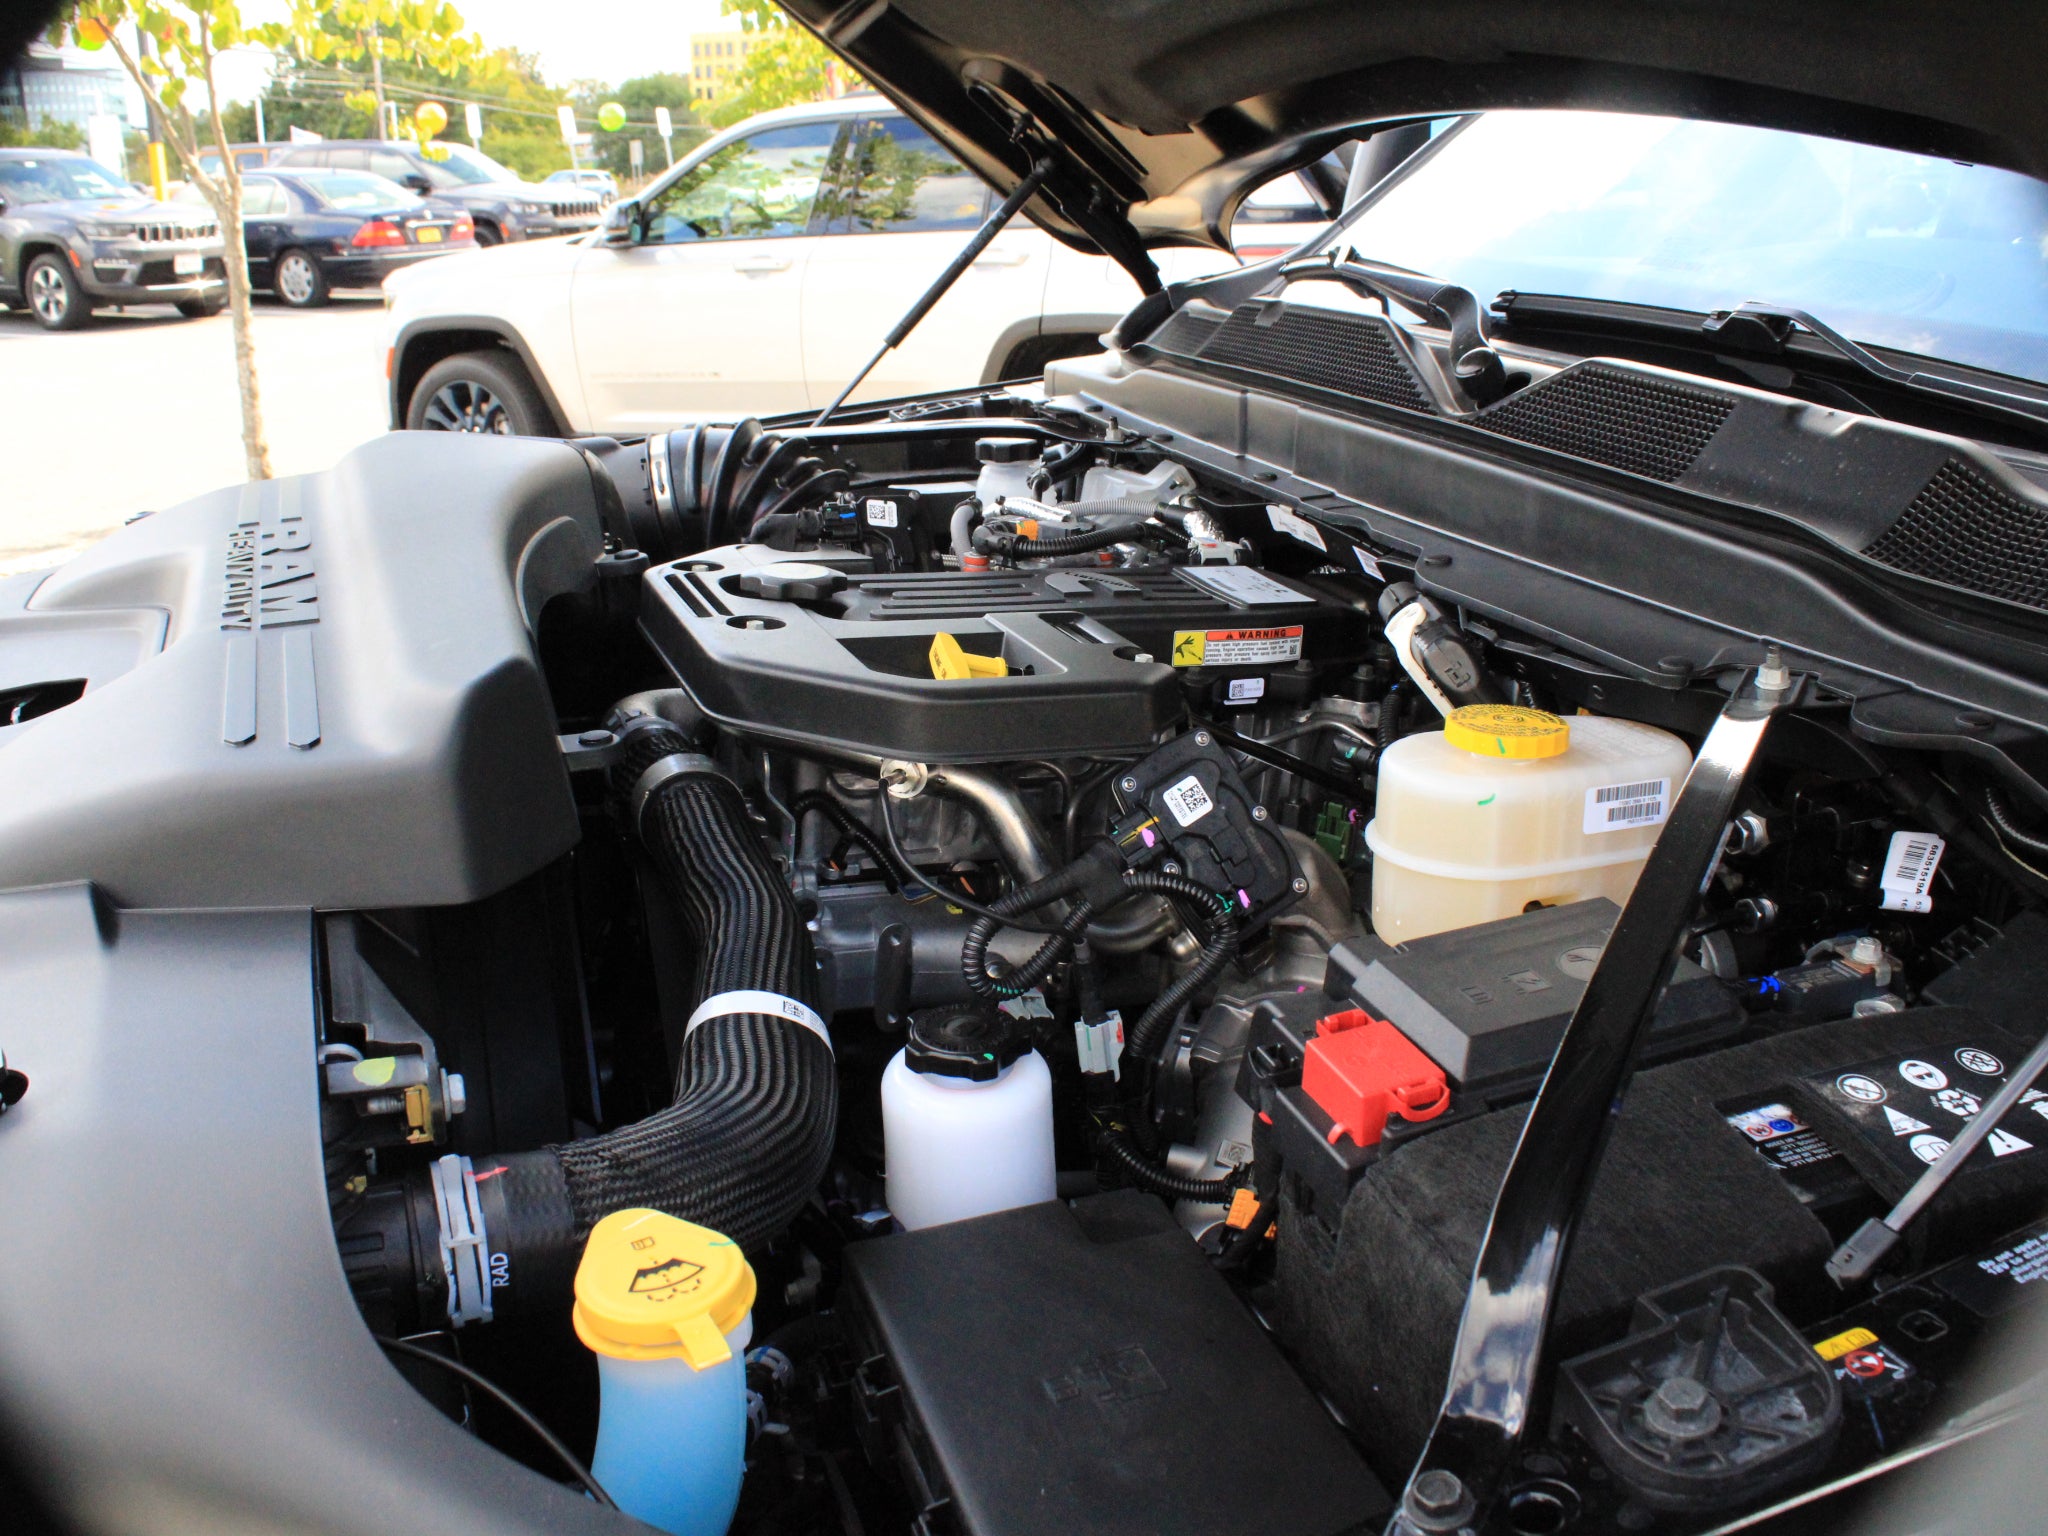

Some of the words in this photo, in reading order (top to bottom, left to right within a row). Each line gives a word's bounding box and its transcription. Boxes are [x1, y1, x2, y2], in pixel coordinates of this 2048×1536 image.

[224, 529, 254, 579] HEAVY
[260, 522, 320, 629] RAM
[220, 580, 253, 630] DUTY
[1238, 629, 1287, 640] WARNING
[490, 1252, 511, 1287] RAD
